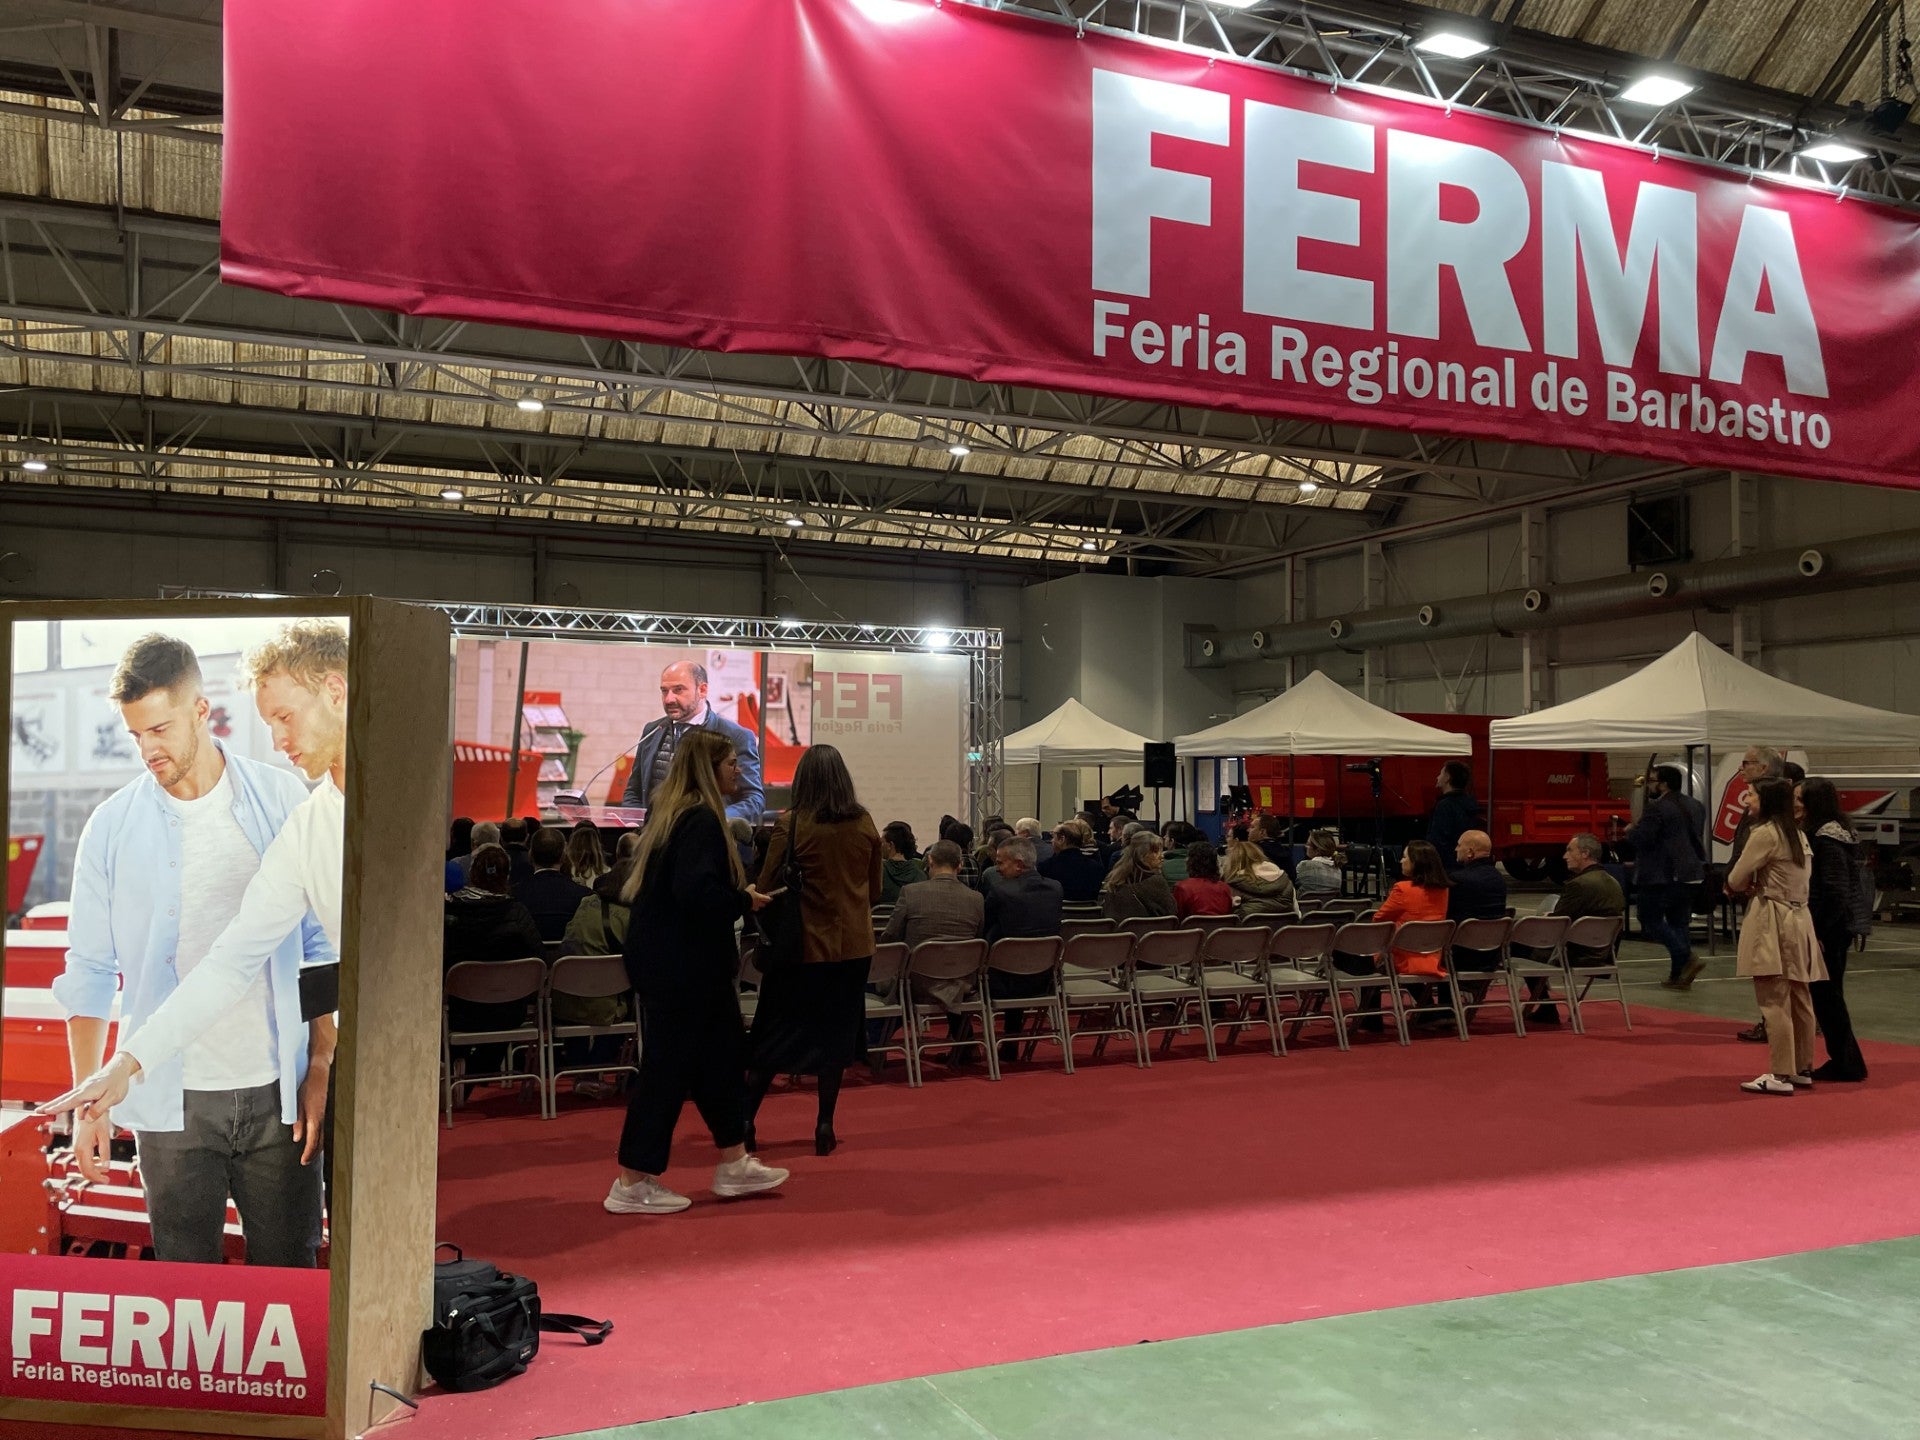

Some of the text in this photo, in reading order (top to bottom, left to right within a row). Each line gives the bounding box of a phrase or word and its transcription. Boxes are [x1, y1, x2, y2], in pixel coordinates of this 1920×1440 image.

[1091, 67, 1829, 398] FERMA
[1093, 299, 1831, 449] Feria Regional de Barbastro
[12, 1289, 307, 1378] FERMA
[12, 1360, 307, 1400] Feria Regional de Barbastro
